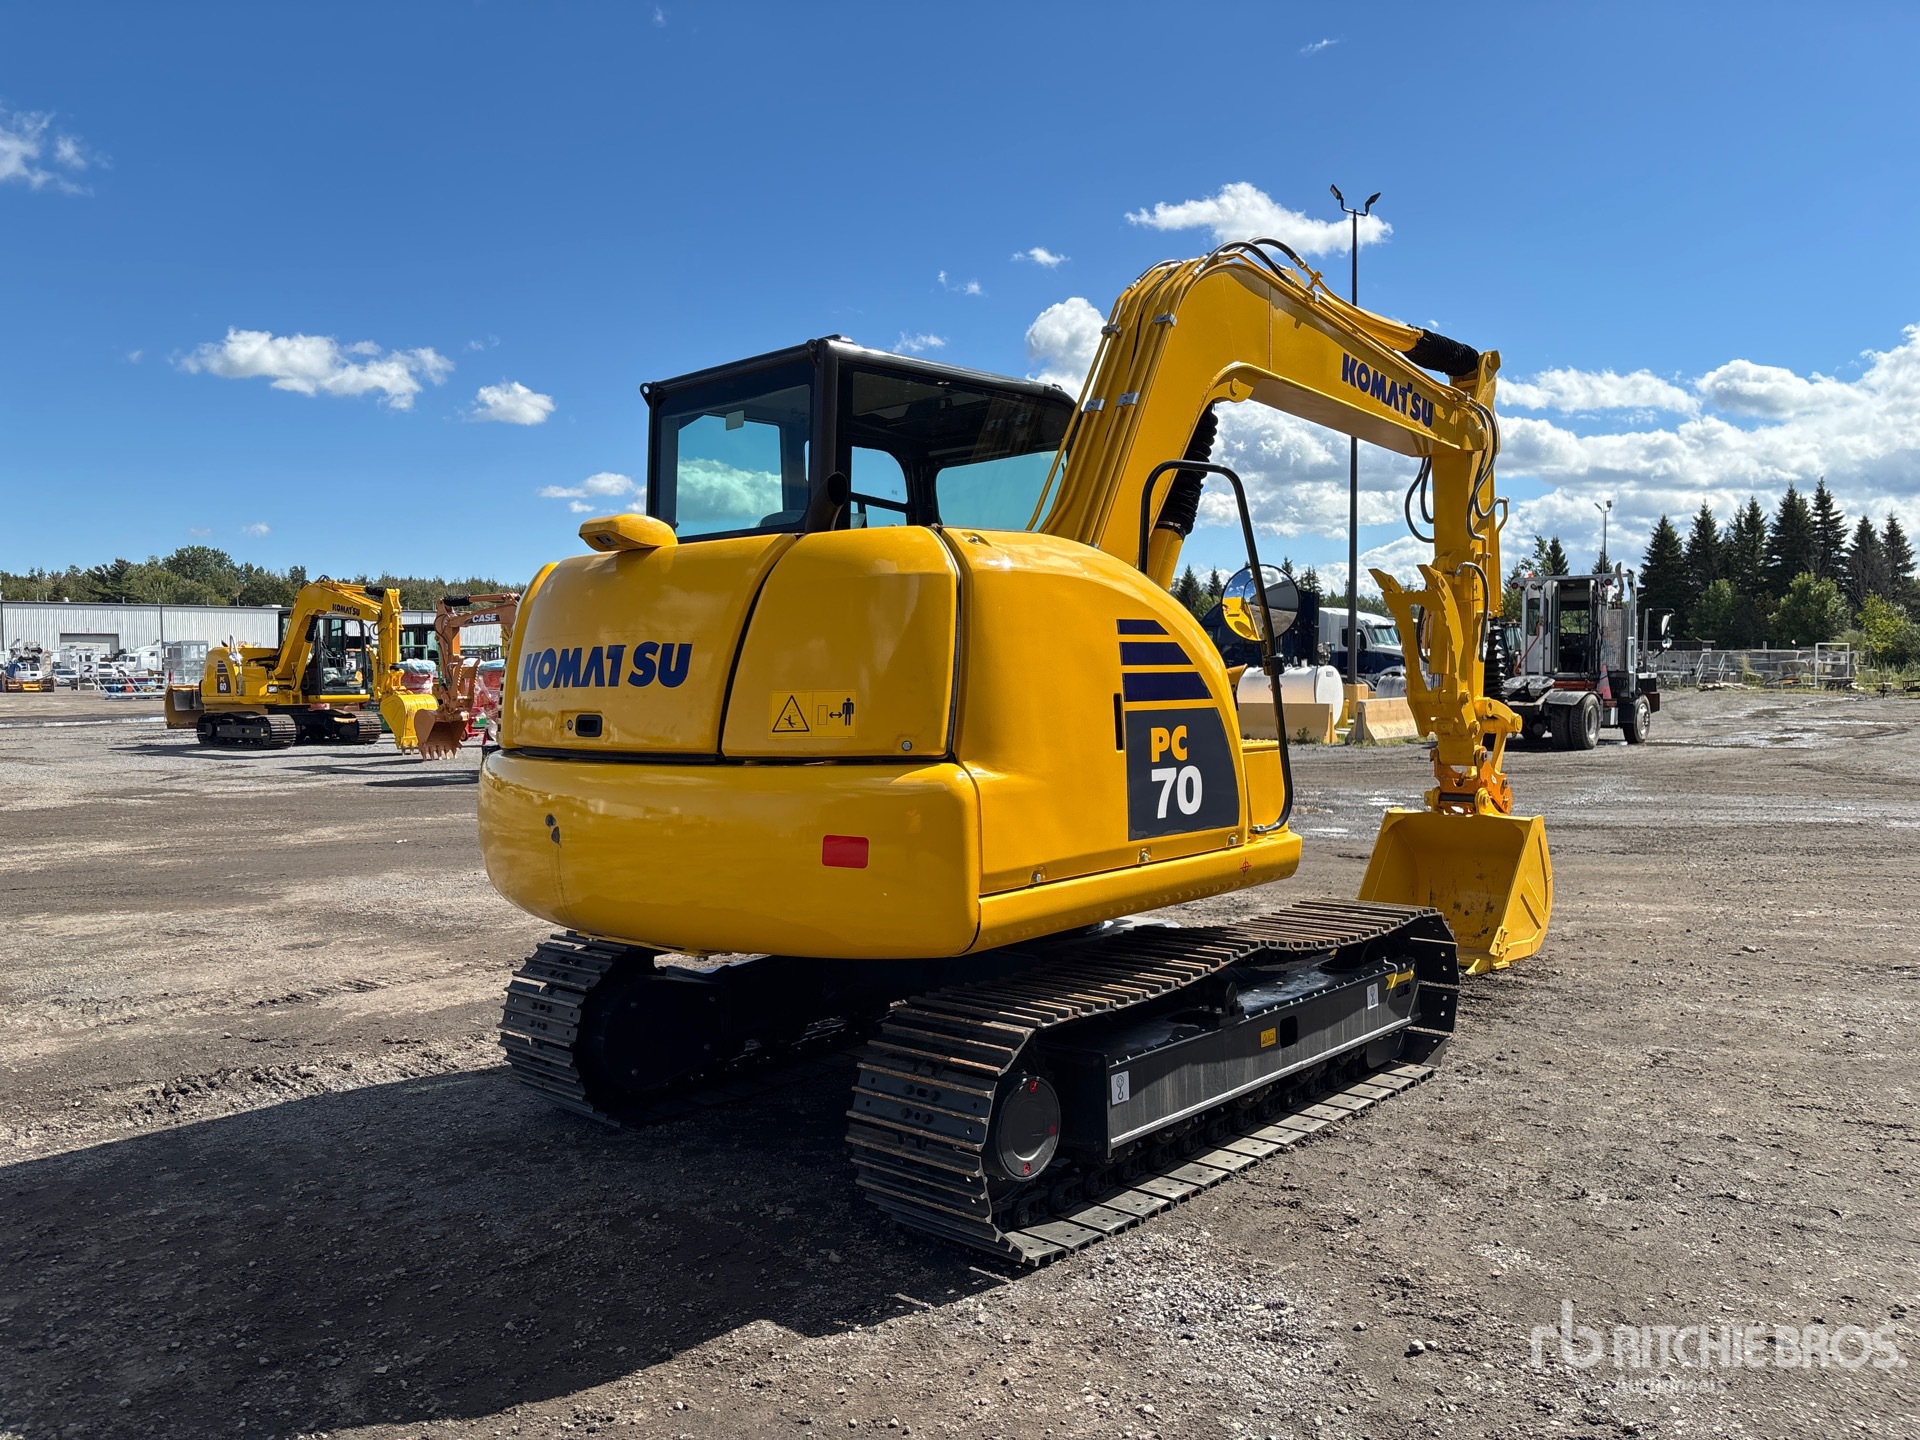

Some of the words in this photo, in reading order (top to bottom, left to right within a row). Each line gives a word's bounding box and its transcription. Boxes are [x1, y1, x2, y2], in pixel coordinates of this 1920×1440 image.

[1342, 353, 1433, 427] KOMATSU
[332, 603, 360, 616] KOMATSU
[472, 613, 497, 623] CASE
[83, 664, 93, 673] 2
[521, 641, 693, 692] KOMATSU
[219, 683, 227, 691] 60
[1150, 725, 1188, 763] PC
[1151, 765, 1203, 819] 70
